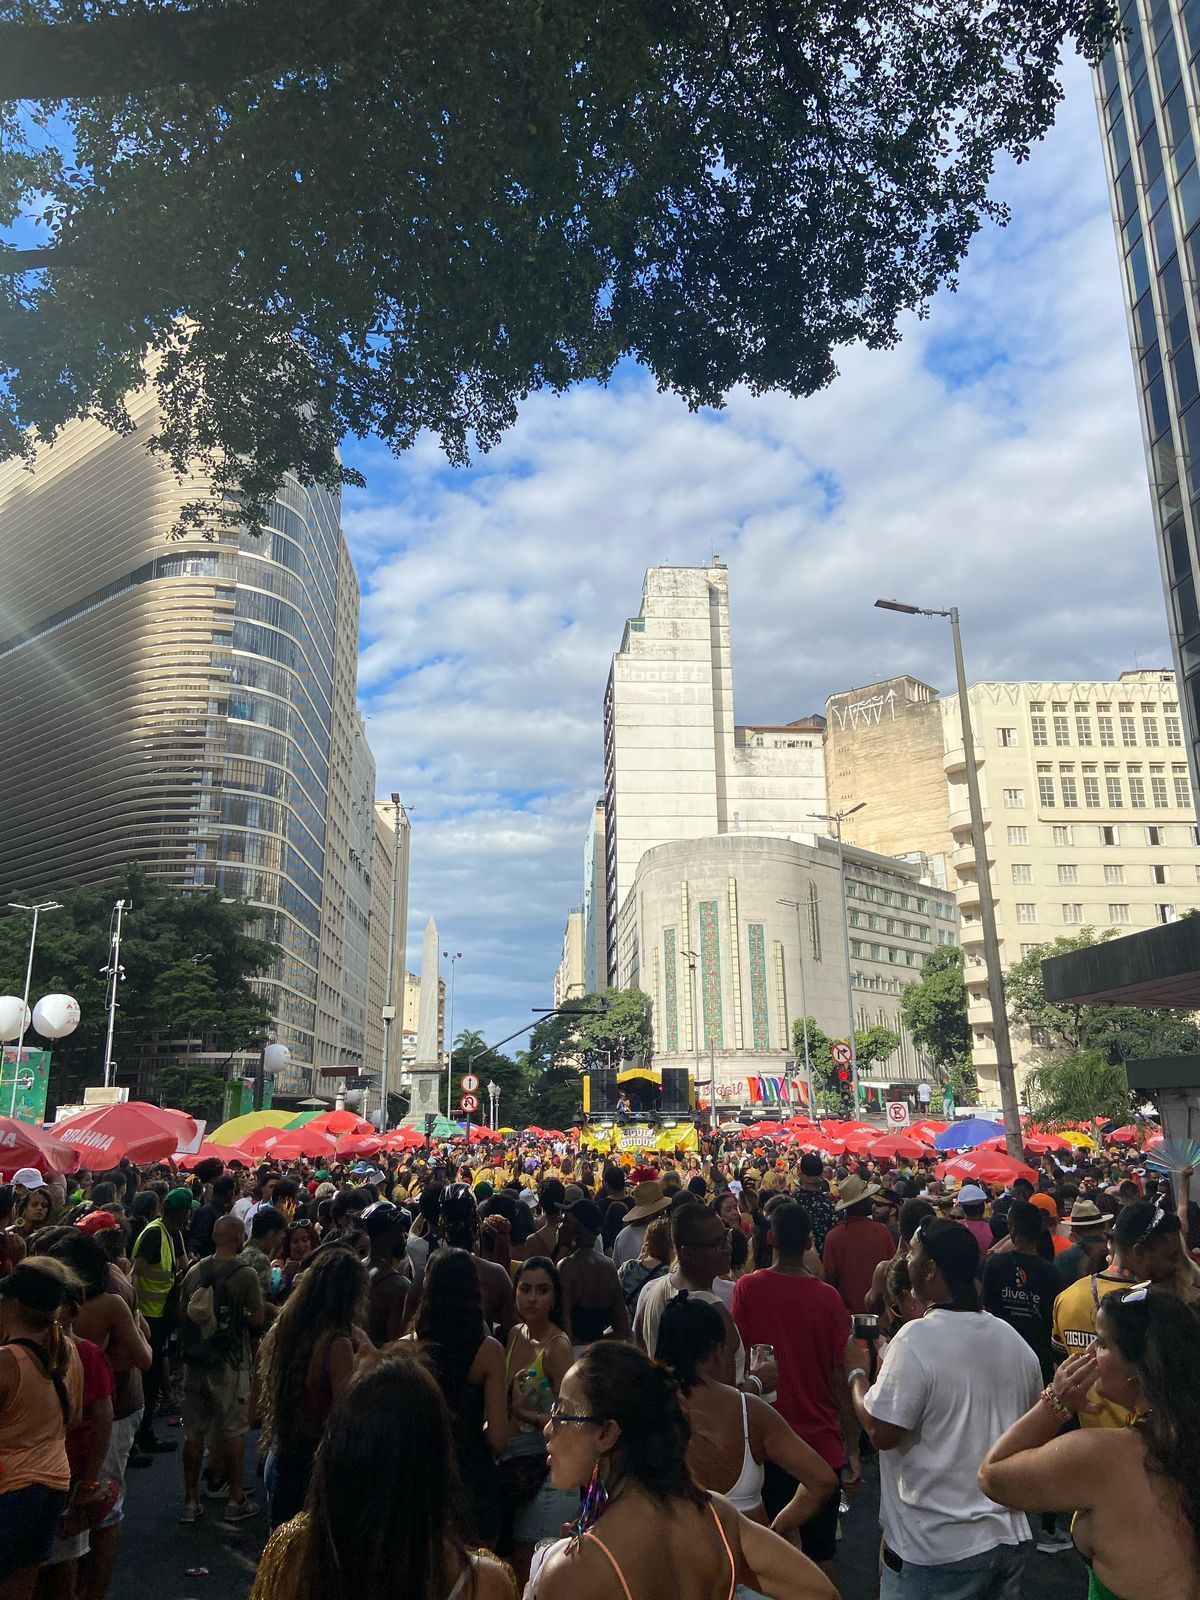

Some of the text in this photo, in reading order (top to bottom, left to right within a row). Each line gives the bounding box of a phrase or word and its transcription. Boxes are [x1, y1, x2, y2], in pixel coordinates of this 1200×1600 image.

[702, 1081, 743, 1096] Basil
[60, 1128, 115, 1151] BRAHMA
[620, 1138, 657, 1149] GUIDUM
[1002, 1286, 1041, 1304] divee
